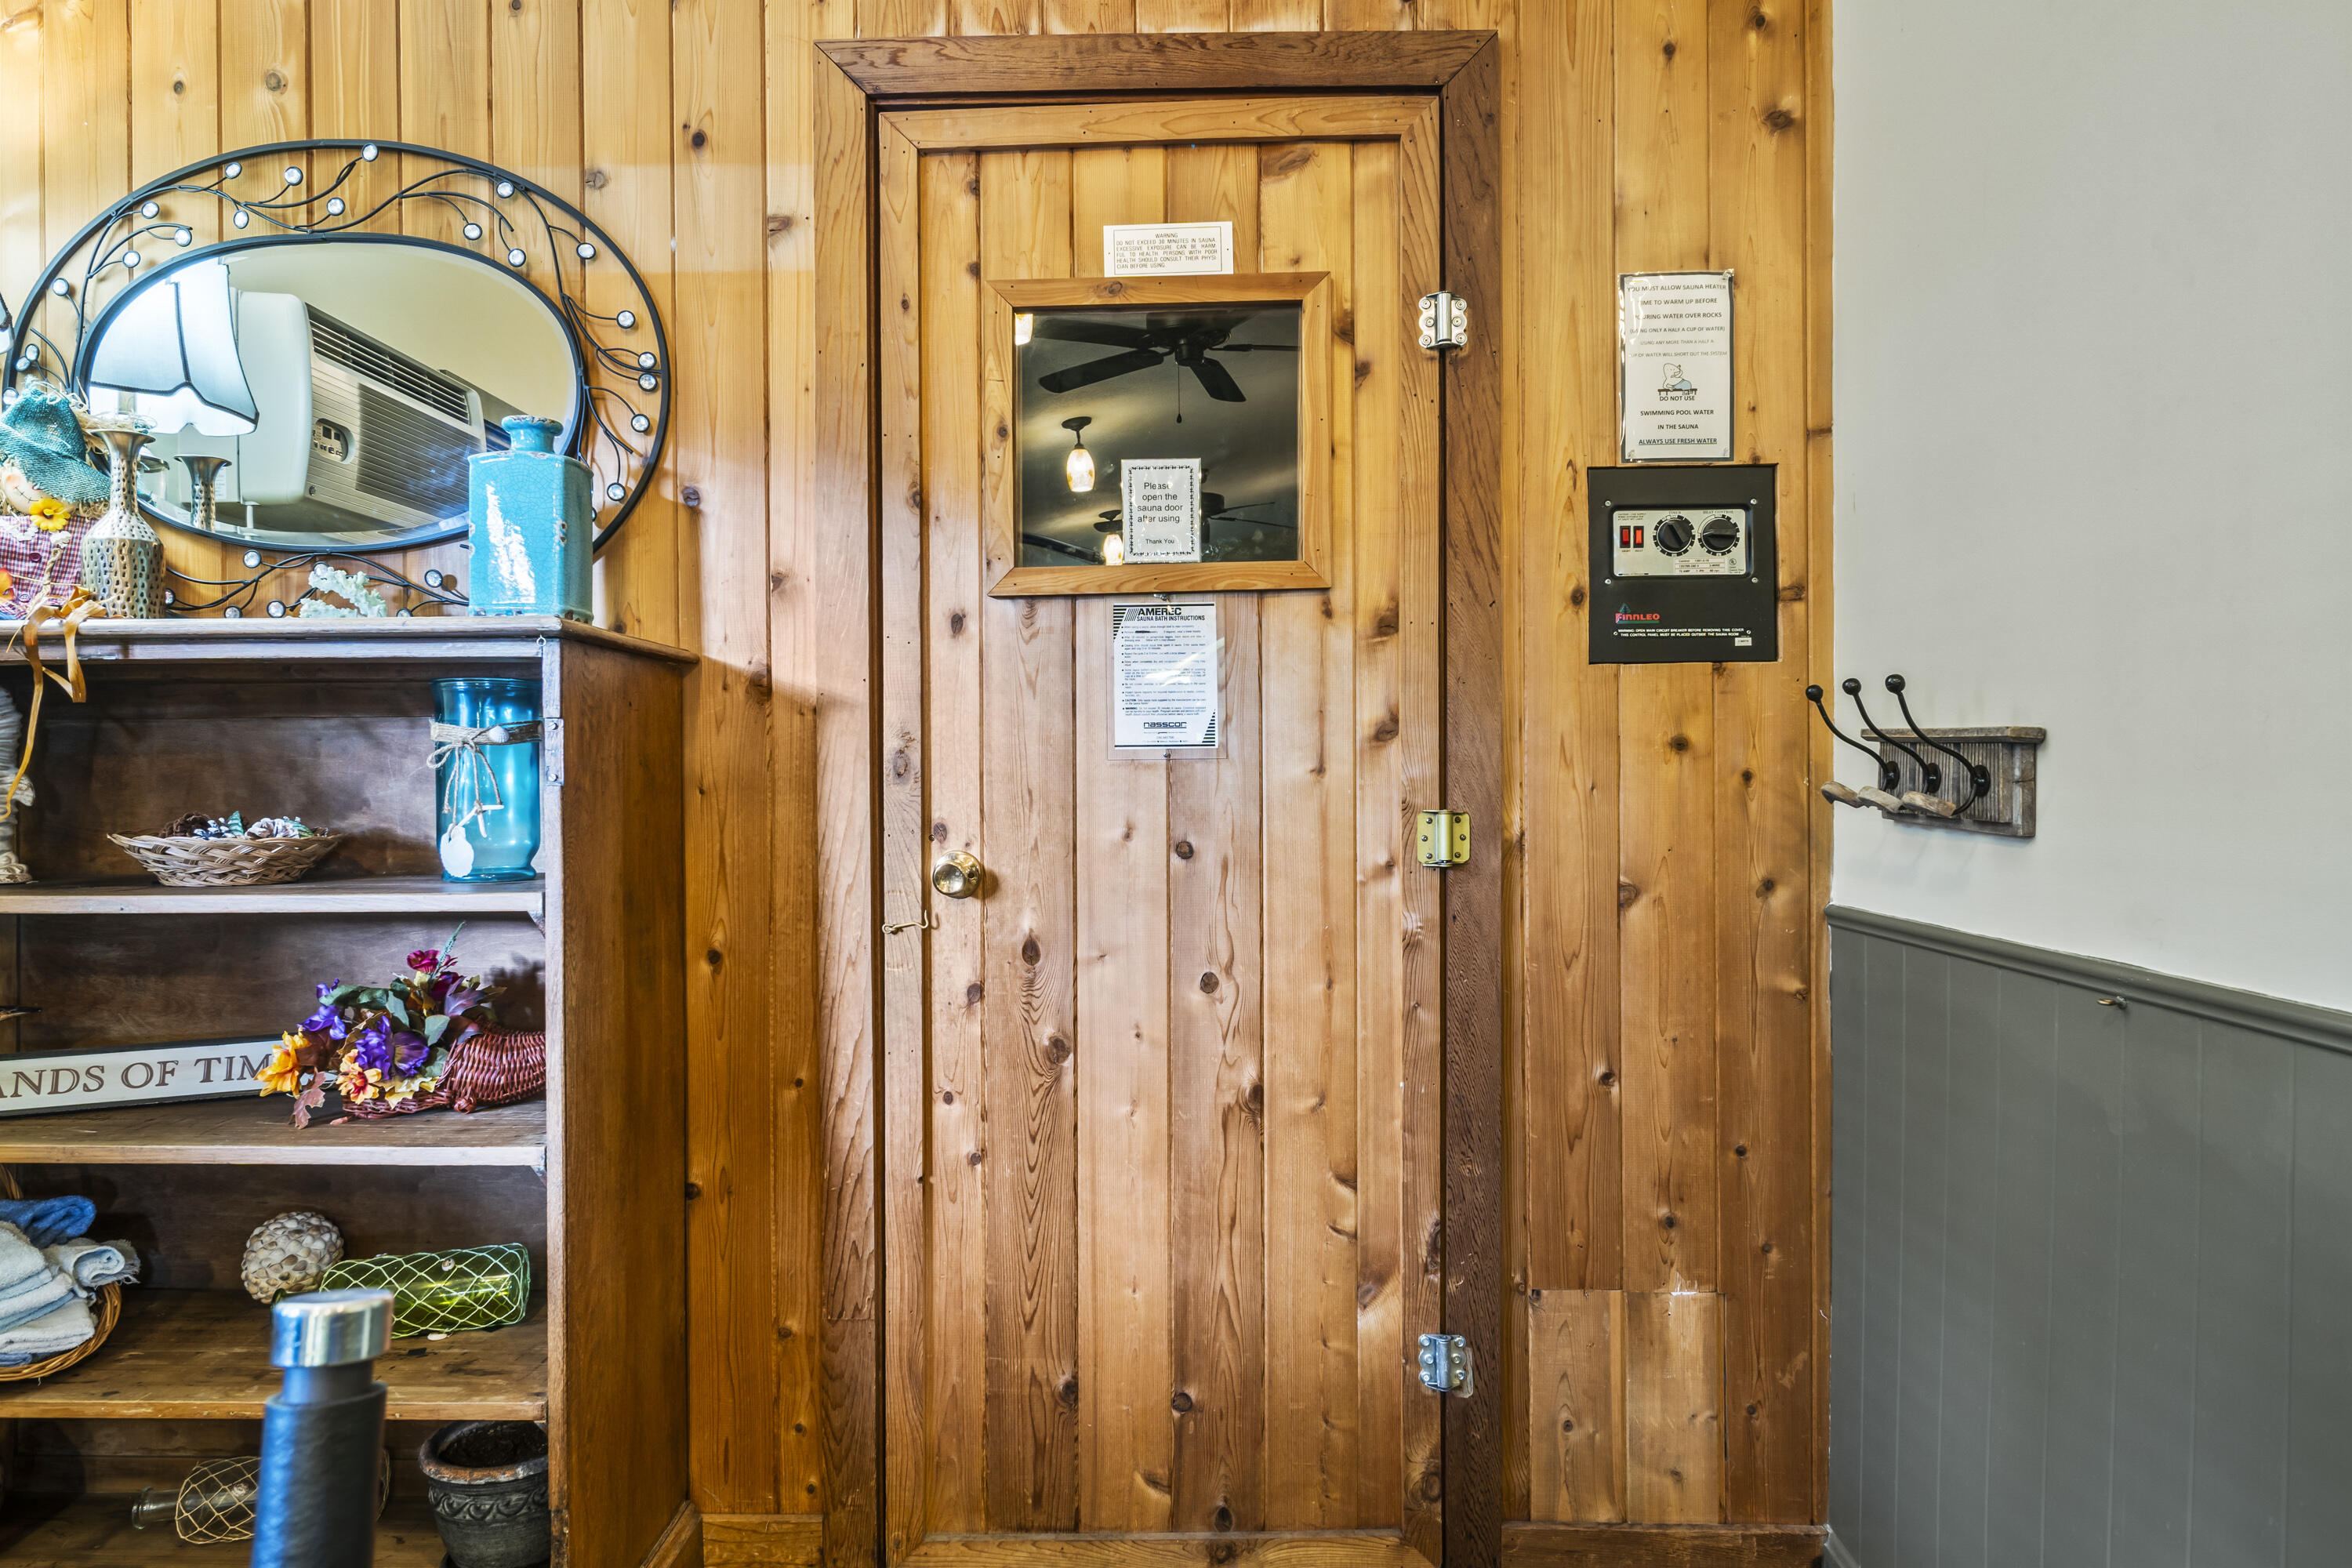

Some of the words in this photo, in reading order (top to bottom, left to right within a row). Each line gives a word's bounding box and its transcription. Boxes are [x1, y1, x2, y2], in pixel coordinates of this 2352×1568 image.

[1142, 494, 1162, 503] open
[1138, 608, 1182, 616] AMEREC
[0, 1065, 104, 1098] NDS
[121, 1060, 180, 1090] OF
[194, 1053, 274, 1083] TIM
